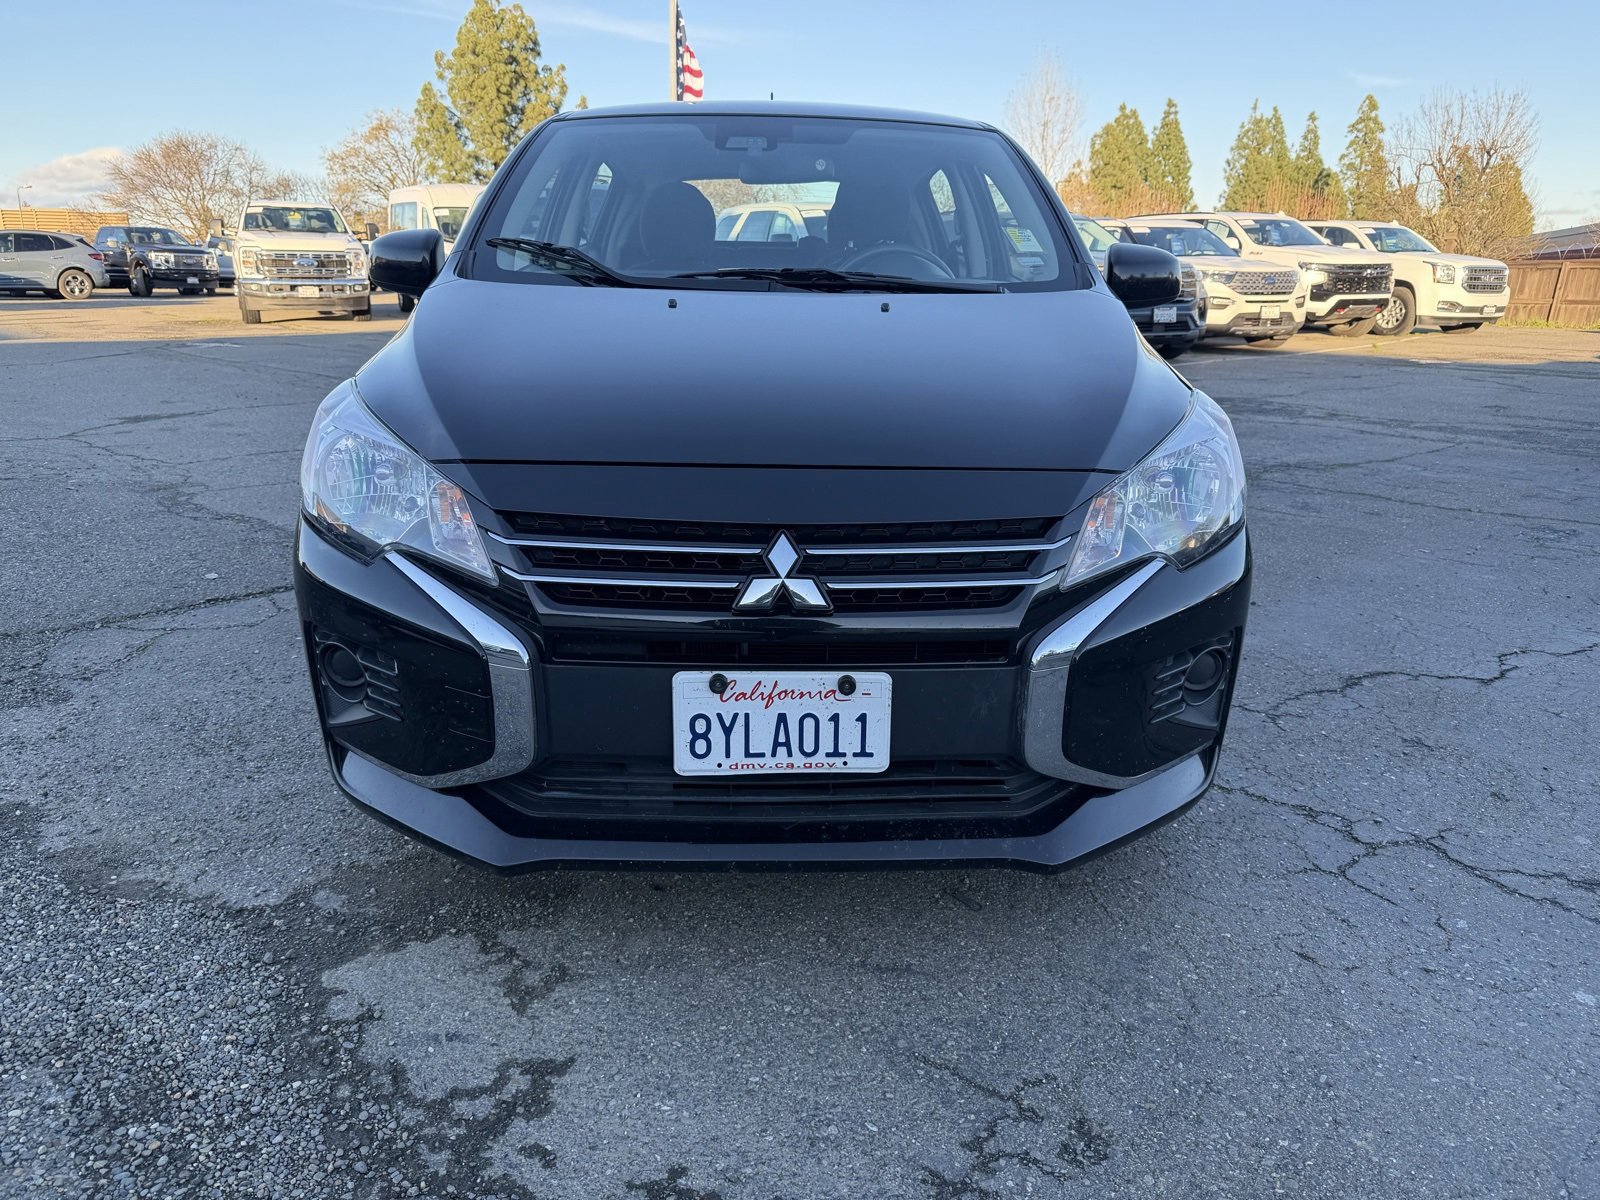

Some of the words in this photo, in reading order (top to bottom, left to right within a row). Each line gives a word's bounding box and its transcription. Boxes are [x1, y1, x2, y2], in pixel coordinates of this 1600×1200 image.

[719, 679, 851, 709] California
[689, 712, 874, 759] 8YLA011
[728, 761, 837, 770] dmv.ca.gov
